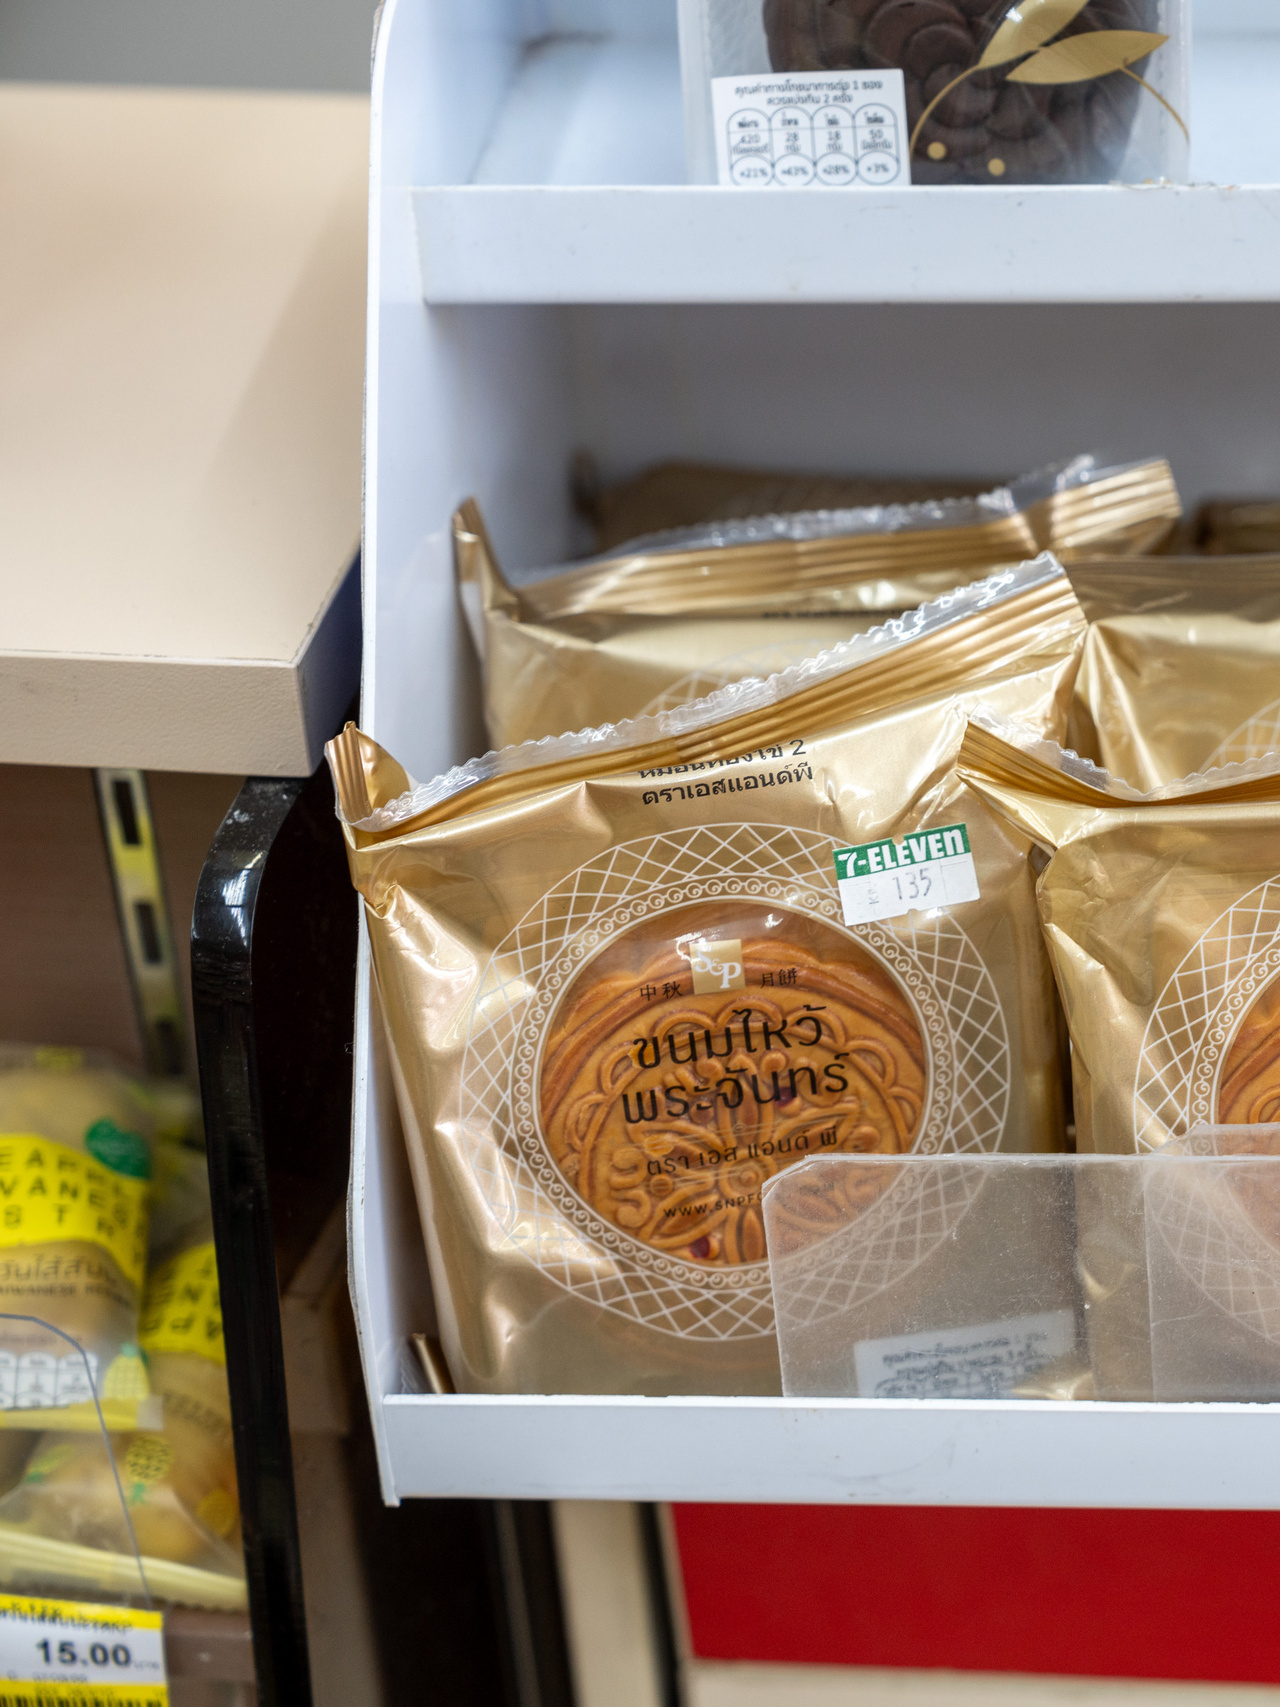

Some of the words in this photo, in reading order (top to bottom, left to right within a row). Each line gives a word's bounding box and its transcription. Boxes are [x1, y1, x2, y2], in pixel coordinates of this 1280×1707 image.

[791, 739, 807, 756] 2
[642, 762, 814, 806] ตราเอสแอนด์พี
[892, 867, 932, 901] 135
[695, 944, 742, 989] S&P
[640, 981, 683, 1001] 中秋
[633, 1004, 827, 1070] ขนมไหว้
[622, 1052, 851, 1124] พระจันทร์
[646, 1152, 691, 1177] ตรา
[699, 1146, 739, 1167] เอส
[748, 1130, 810, 1159] แอนด์
[820, 1125, 838, 1147] พี
[36, 1637, 132, 1669] 15.00
